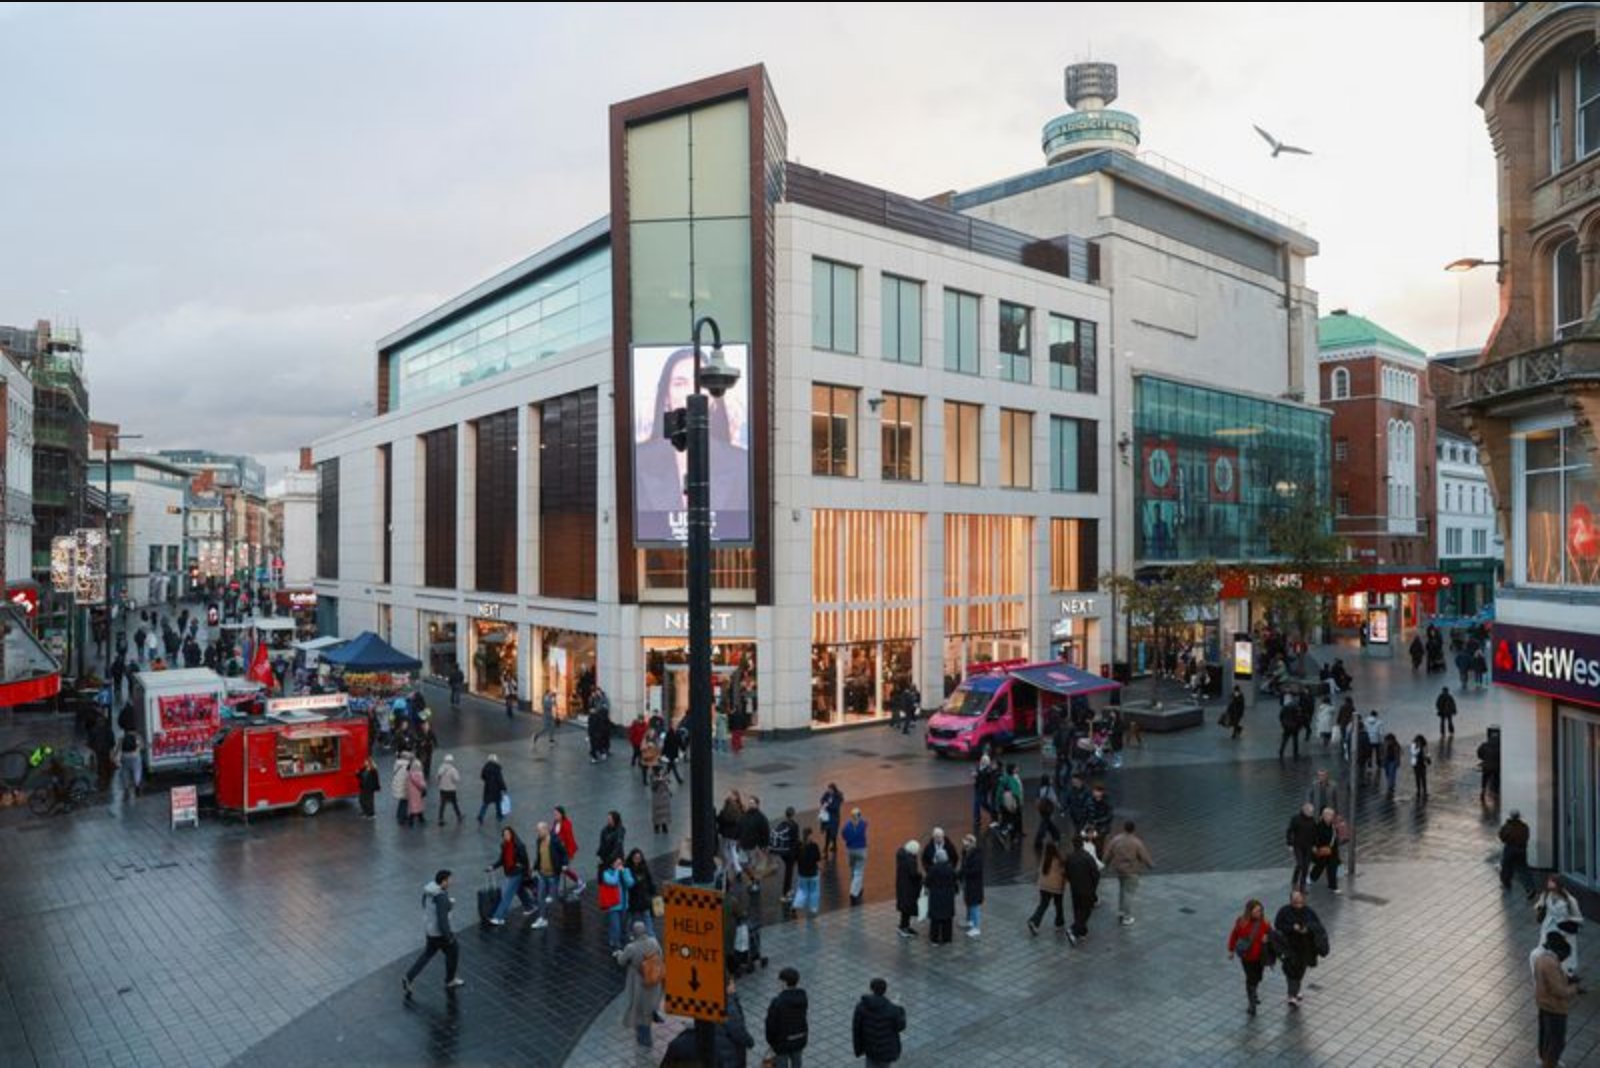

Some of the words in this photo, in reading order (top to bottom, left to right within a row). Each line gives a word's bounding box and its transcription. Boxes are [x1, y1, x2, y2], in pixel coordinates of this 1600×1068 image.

[1061, 599, 1097, 614] NEXT
[664, 612, 732, 630] NT
[1516, 640, 1600, 687] NatWes
[673, 917, 715, 934] HELP
[669, 943, 720, 963] POINT
